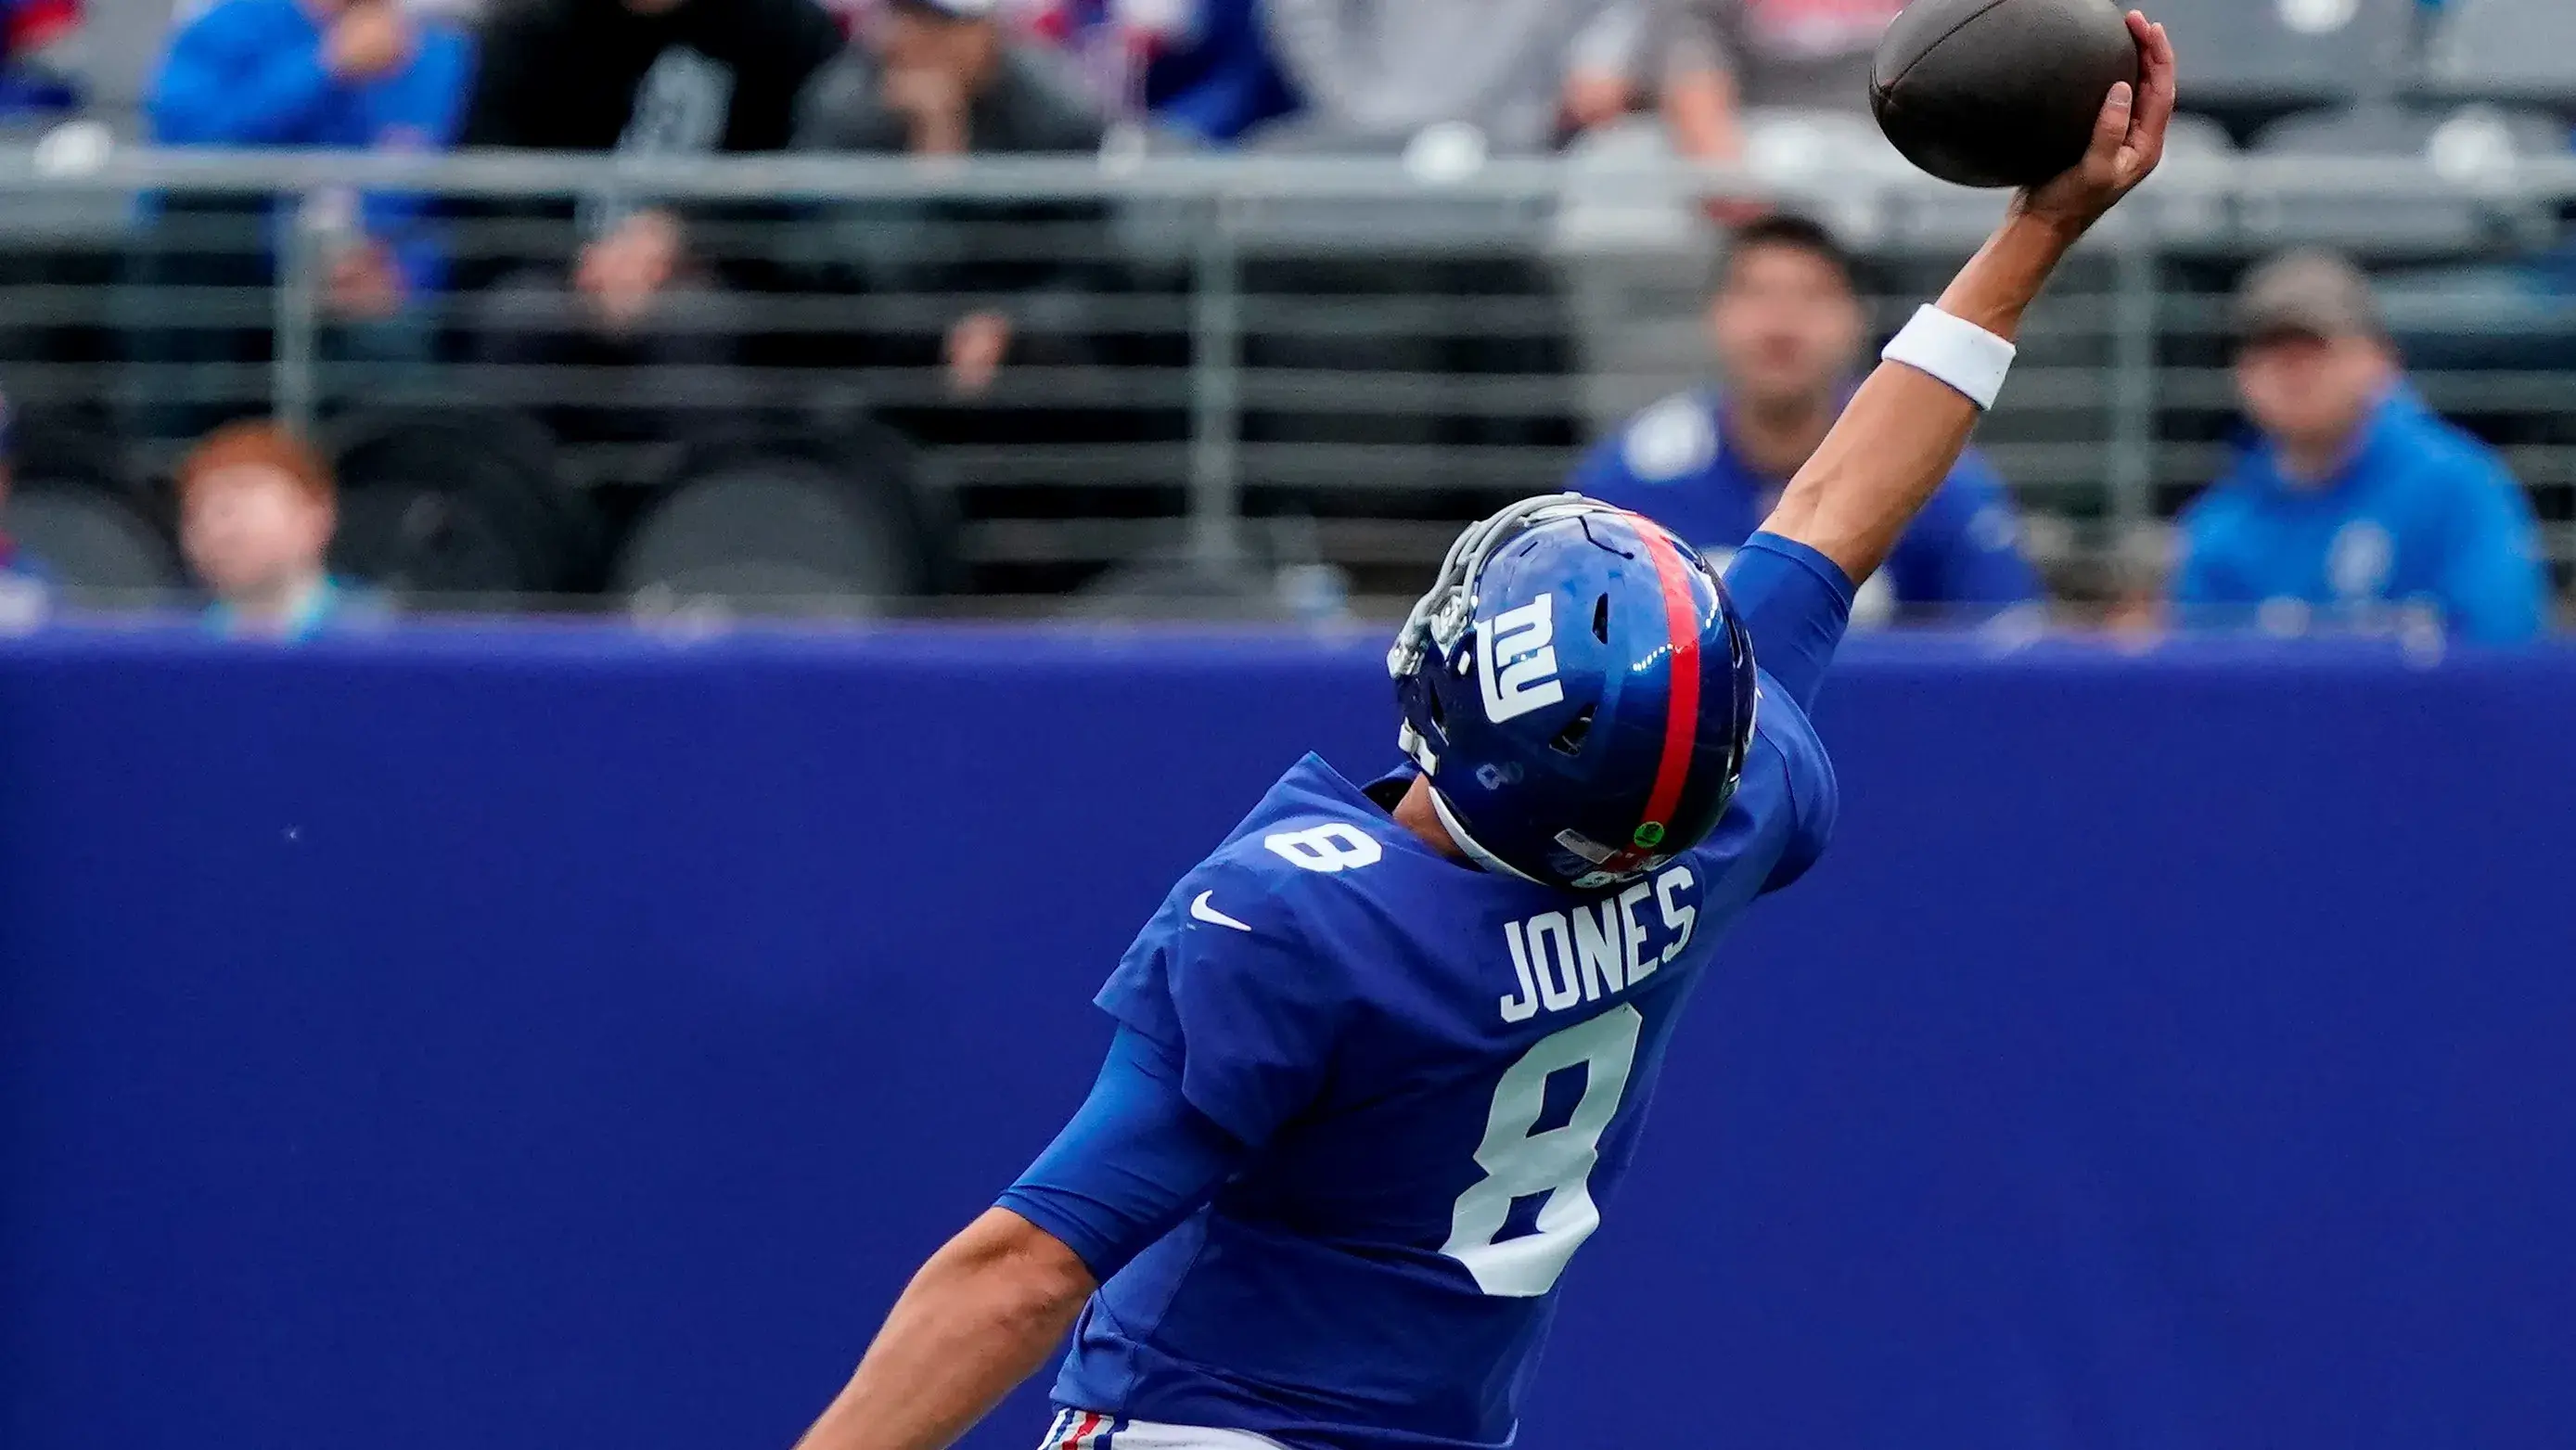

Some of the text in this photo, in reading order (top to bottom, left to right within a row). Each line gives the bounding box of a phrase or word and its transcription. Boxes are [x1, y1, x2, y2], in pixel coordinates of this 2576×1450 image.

[1264, 823, 1382, 872] 8
[1500, 866, 1696, 1022] JONES
[1439, 1003, 1643, 1298] 8
